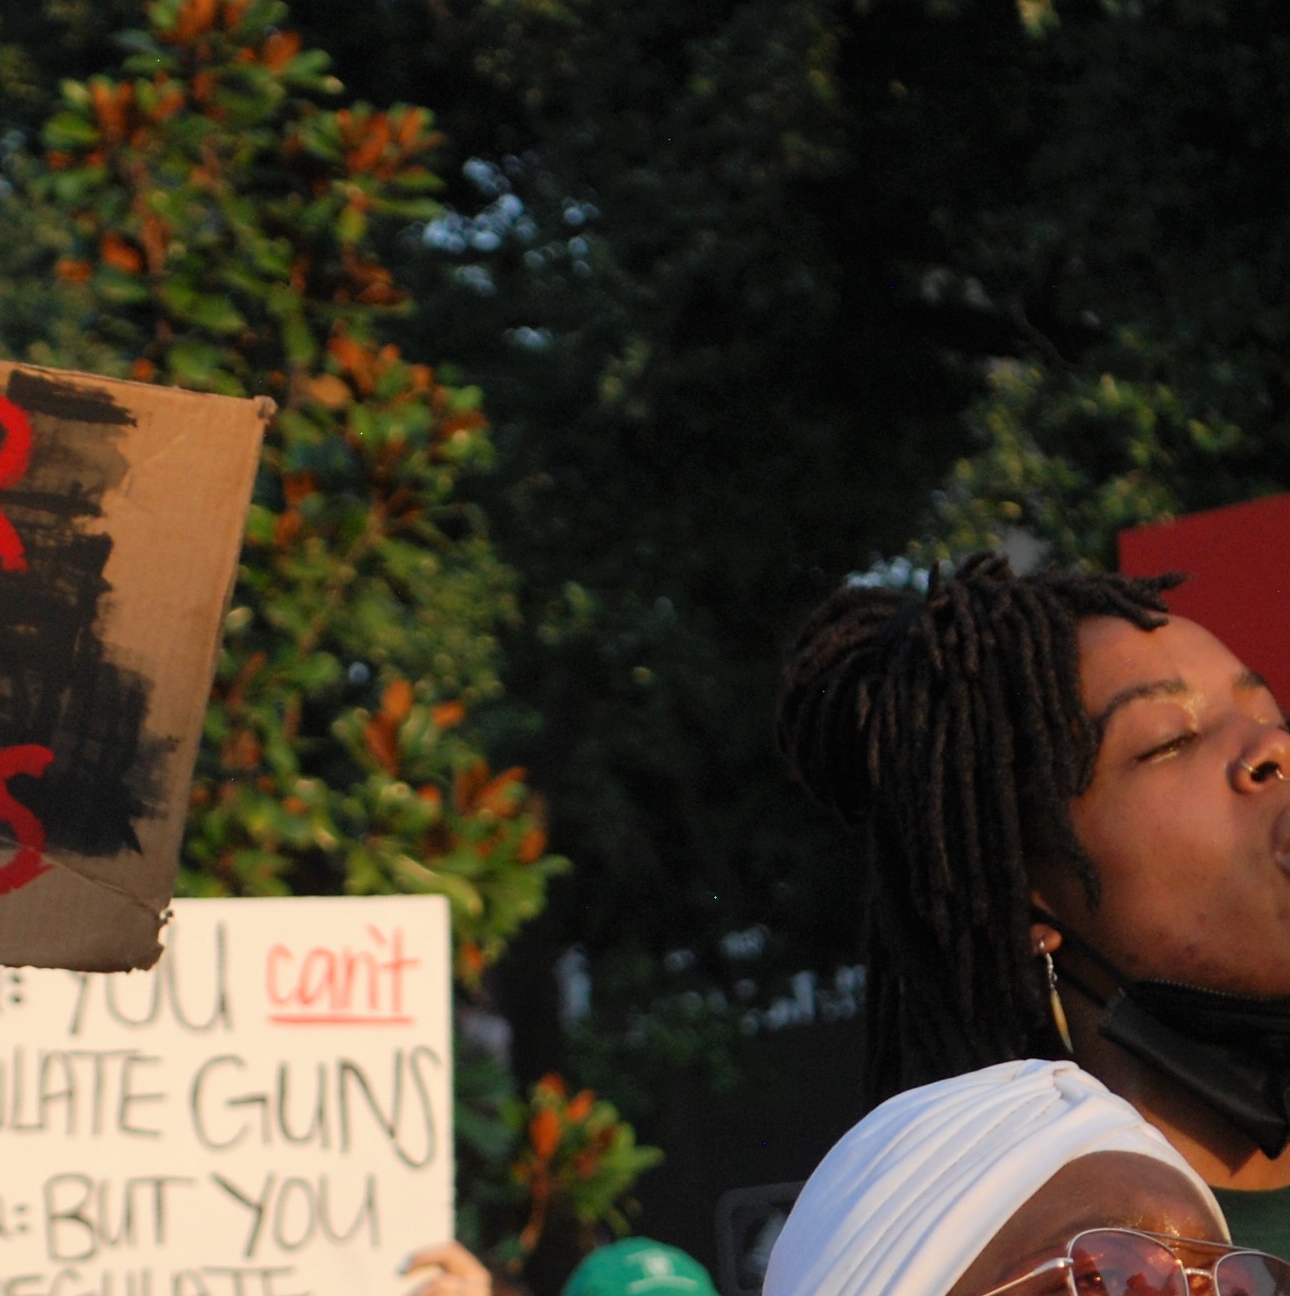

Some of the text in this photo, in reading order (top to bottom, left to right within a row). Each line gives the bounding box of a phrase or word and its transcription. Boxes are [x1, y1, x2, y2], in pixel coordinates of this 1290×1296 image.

[265, 923, 421, 1013] can't
[189, 1044, 443, 1170] GUNS
[42, 1173, 197, 1263] BUT
[210, 1172, 383, 1258] YOU
